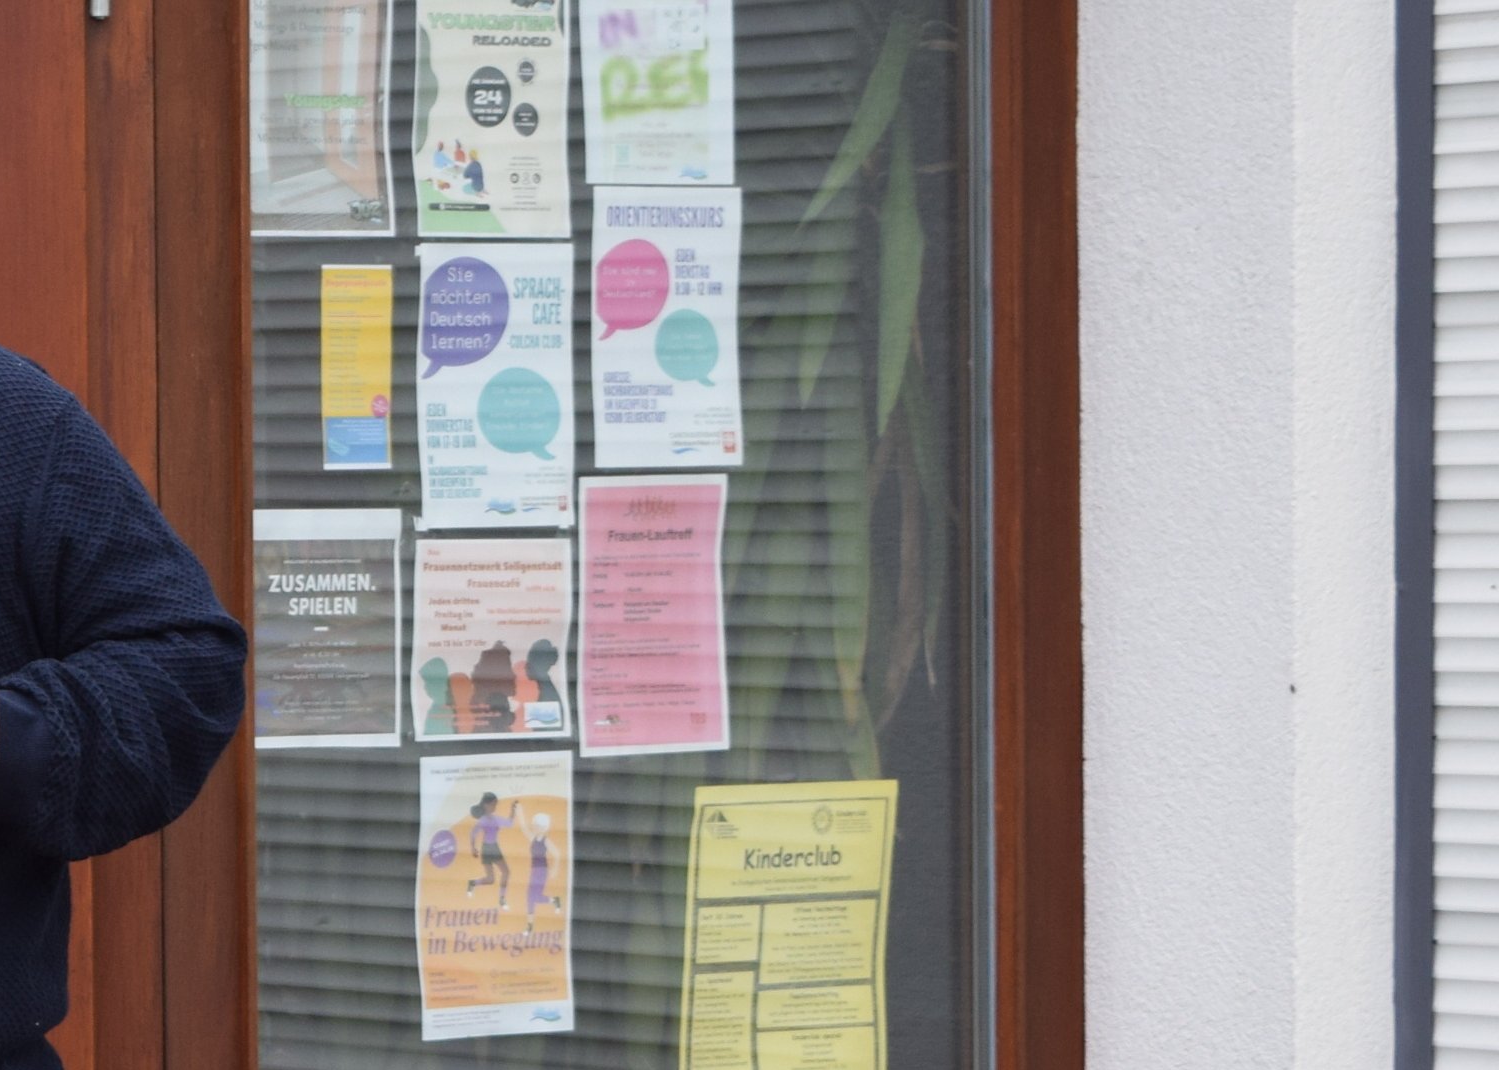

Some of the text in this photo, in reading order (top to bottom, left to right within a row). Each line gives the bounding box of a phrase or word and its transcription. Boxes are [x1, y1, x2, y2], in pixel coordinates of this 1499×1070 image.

[472, 35, 552, 47] RELOADED
[473, 90, 503, 106] 24
[606, 205, 724, 229] ORIENTIERUNGSKURS
[447, 267, 473, 283] Sie
[513, 277, 565, 300] SPRACH-
[430, 289, 491, 305] möchten
[430, 312, 491, 327] Deutsch
[430, 333, 491, 350] lernen?
[607, 528, 694, 544] Frauen-Lauftreff
[423, 561, 564, 574] Frauennetzwerk Seligenstadt
[267, 573, 377, 593] ZUSAMMEN.
[287, 597, 357, 616] SPIELEN
[441, 623, 467, 632] Monat
[743, 844, 842, 871] Kinderclub
[424, 906, 499, 929] Frauen
[428, 928, 563, 958] in Bewegung
